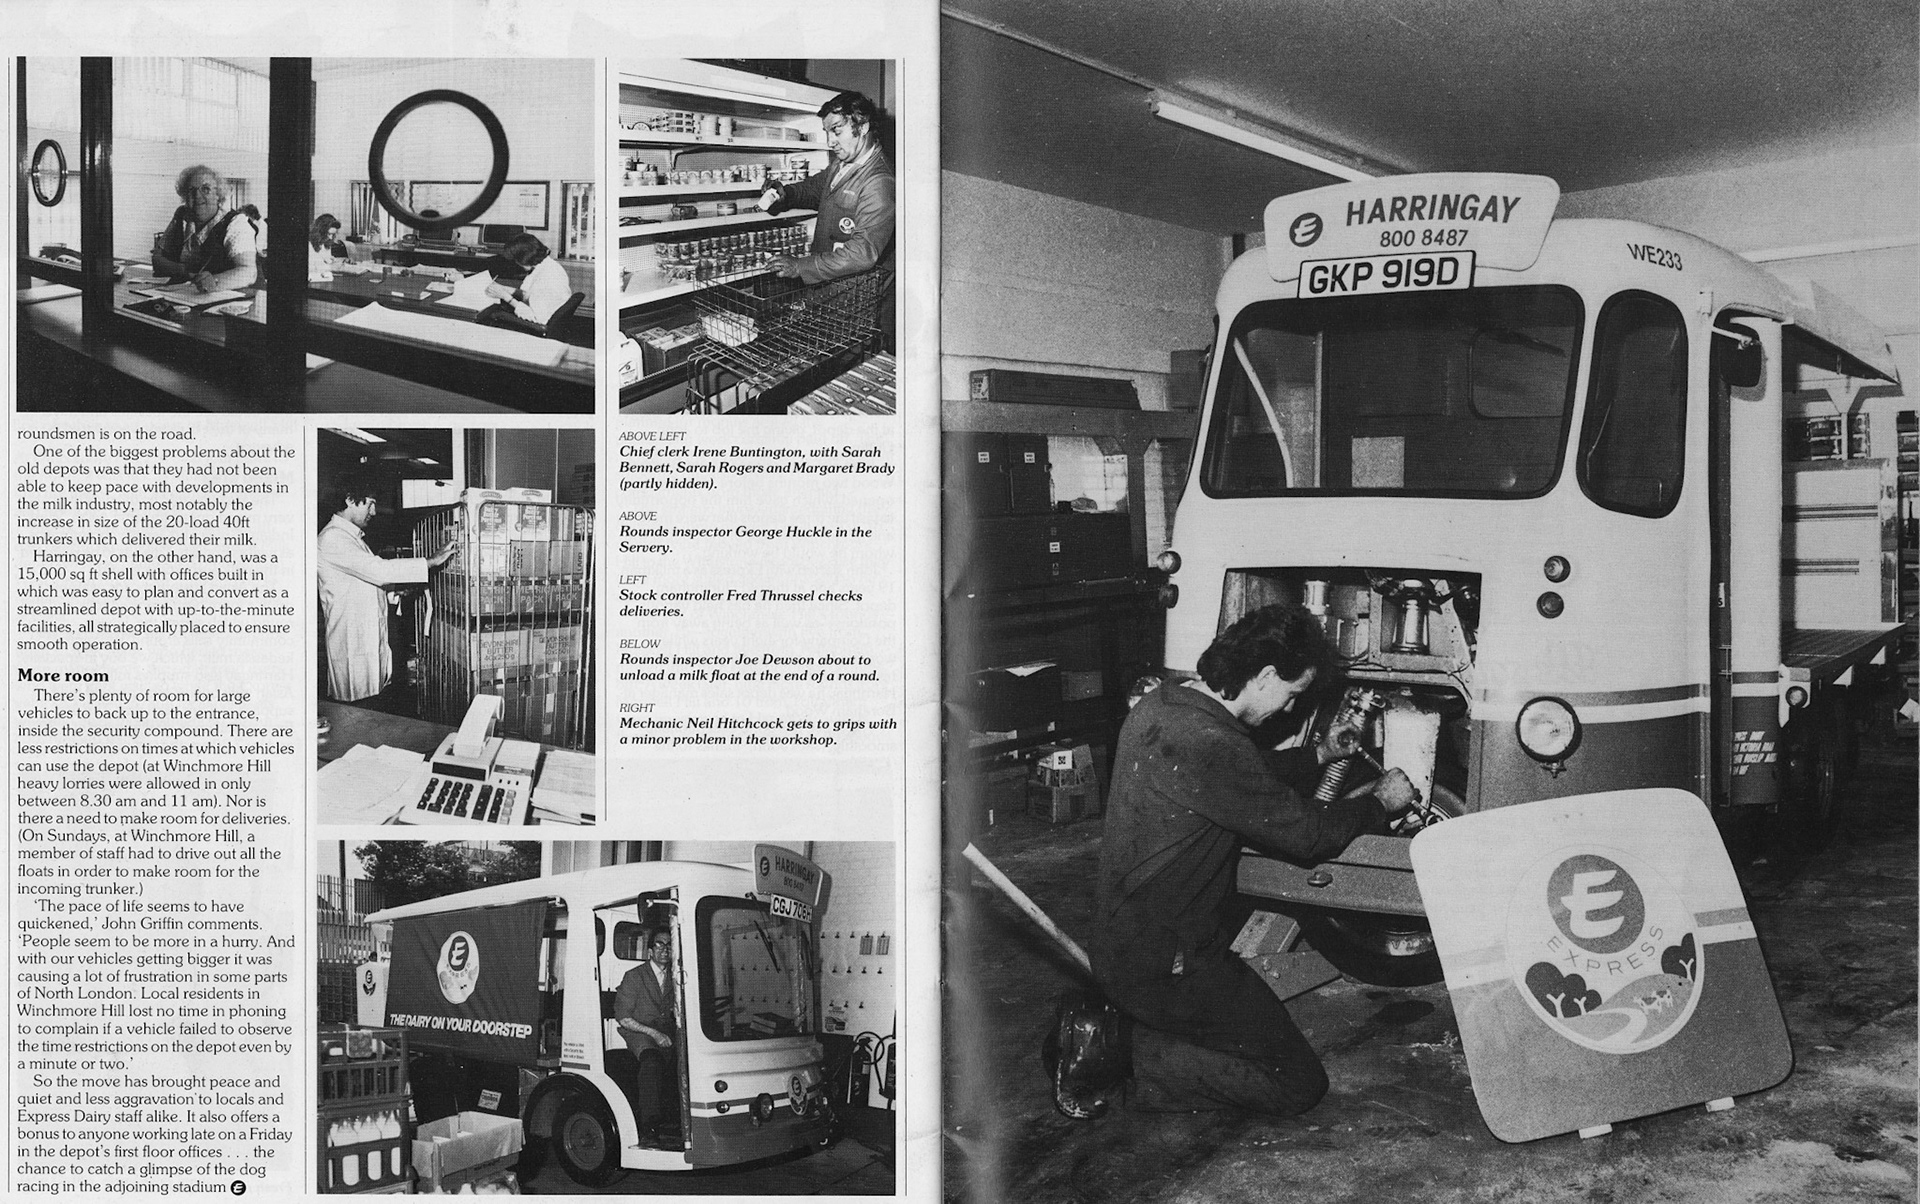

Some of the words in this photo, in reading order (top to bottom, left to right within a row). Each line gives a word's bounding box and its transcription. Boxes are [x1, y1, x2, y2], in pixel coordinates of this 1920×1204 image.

[1346, 194, 1521, 226] HARRINGAY
[1380, 230, 1415, 247] 800
[1421, 229, 1469, 246] 8487
[1626, 243, 1683, 271] WE233
[1309, 262, 1374, 294] GKP
[1382, 257, 1459, 288] 919D
[17, 426, 96, 440] roundsmen
[99, 430, 110, 440] is
[113, 430, 132, 440] on
[135, 426, 157, 440] the
[161, 427, 196, 440] road.
[618, 431, 658, 442] ABOVE
[659, 431, 688, 442] LEFT
[619, 445, 656, 460] Chief
[657, 445, 690, 458] clerk
[692, 445, 727, 458] Irene
[729, 445, 806, 460] Buntington,
[809, 445, 839, 458] with
[841, 445, 881, 458] Sarah
[619, 461, 674, 474] Bennett,
[675, 461, 716, 474] Sarah
[718, 461, 764, 476] Rogers
[766, 461, 792, 474] and
[792, 461, 854, 476] Margaret
[855, 461, 896, 476] Brady
[619, 477, 663, 492] (partly
[665, 477, 718, 491] hidden).
[618, 511, 658, 521] ABOVE
[619, 525, 669, 537] Rounds
[672, 526, 733, 540] inspector
[735, 525, 783, 540] George
[785, 525, 833, 538] Huckle
[835, 526, 848, 538] in
[851, 526, 873, 538] the
[618, 540, 673, 556] Servery.
[619, 575, 645, 585] LEFT
[618, 588, 658, 601] Stock
[660, 589, 724, 601] controller
[726, 589, 757, 601] Fred
[760, 589, 815, 602] Thrussel
[817, 589, 863, 602] checks
[619, 604, 684, 617] deliveries.
[17, 637, 68, 650] smooth
[72, 638, 143, 653] operation.
[619, 639, 661, 649] BELOW
[619, 652, 670, 665] Rounds
[672, 653, 733, 668] inspector
[734, 653, 759, 665] Joe
[762, 653, 815, 666] Dewson
[817, 653, 855, 666] about
[858, 655, 872, 666] to
[17, 667, 61, 683] More
[64, 672, 109, 683] room
[620, 669, 665, 681] unload
[667, 672, 676, 681] a
[679, 668, 709, 682] milk
[709, 668, 742, 684] float
[743, 671, 757, 681] at
[760, 669, 781, 681] the
[783, 669, 809, 681] end
[810, 669, 826, 684] of
[826, 673, 835, 682] a
[838, 669, 880, 682] round.
[17, 705, 74, 719] vehicles
[76, 708, 91, 719] to
[94, 706, 127, 719] back
[130, 710, 149, 722] up
[152, 708, 167, 719] to
[170, 706, 192, 720] the
[195, 708, 259, 720] entrance,
[619, 703, 654, 713] RIGHT
[18, 723, 58, 737] inside
[62, 723, 84, 737] the
[87, 725, 141, 740] security
[143, 724, 223, 740] compound.
[227, 723, 268, 737] There
[271, 728, 293, 737] are
[619, 717, 684, 729] Mechanic
[686, 717, 715, 729] Neil
[717, 717, 784, 730] Hitchcock
[786, 719, 814, 732] gets
[816, 719, 830, 730] to
[832, 718, 866, 732] grips
[868, 717, 897, 730] with
[619, 736, 628, 745] a
[631, 733, 671, 745] minor
[672, 733, 727, 748] problem
[730, 734, 742, 745] in
[746, 733, 767, 745] the
[769, 733, 837, 748] workshop.
[17, 863, 54, 877] floats
[57, 865, 70, 877] in
[74, 864, 112, 878] order
[115, 866, 129, 878] to
[133, 864, 171, 878] make
[174, 868, 211, 878] room
[215, 864, 235, 878] for
[238, 864, 260, 878] the
[773, 897, 793, 916] CGJ
[1547, 925, 1664, 976] EXPRESS
[390, 1013, 406, 1026] THE
[406, 1014, 432, 1028] DAIRY
[431, 1016, 445, 1029] ON
[446, 1017, 472, 1032] YOUR
[472, 1020, 532, 1039] DOORSTEP
[17, 1109, 71, 1125] Express
[74, 1109, 111, 1126] Dairy
[114, 1109, 143, 1123] staff
[145, 1109, 182, 1123] alike.
[187, 1109, 196, 1123] It
[199, 1109, 227, 1123] also
[230, 1109, 269, 1123] offers
[271, 1114, 280, 1123] a
[17, 1182, 59, 1196] racing
[62, 1183, 75, 1192] in
[79, 1179, 101, 1193] the
[104, 1179, 169, 1196] adjoining
[172, 1179, 226, 1193] stadium
